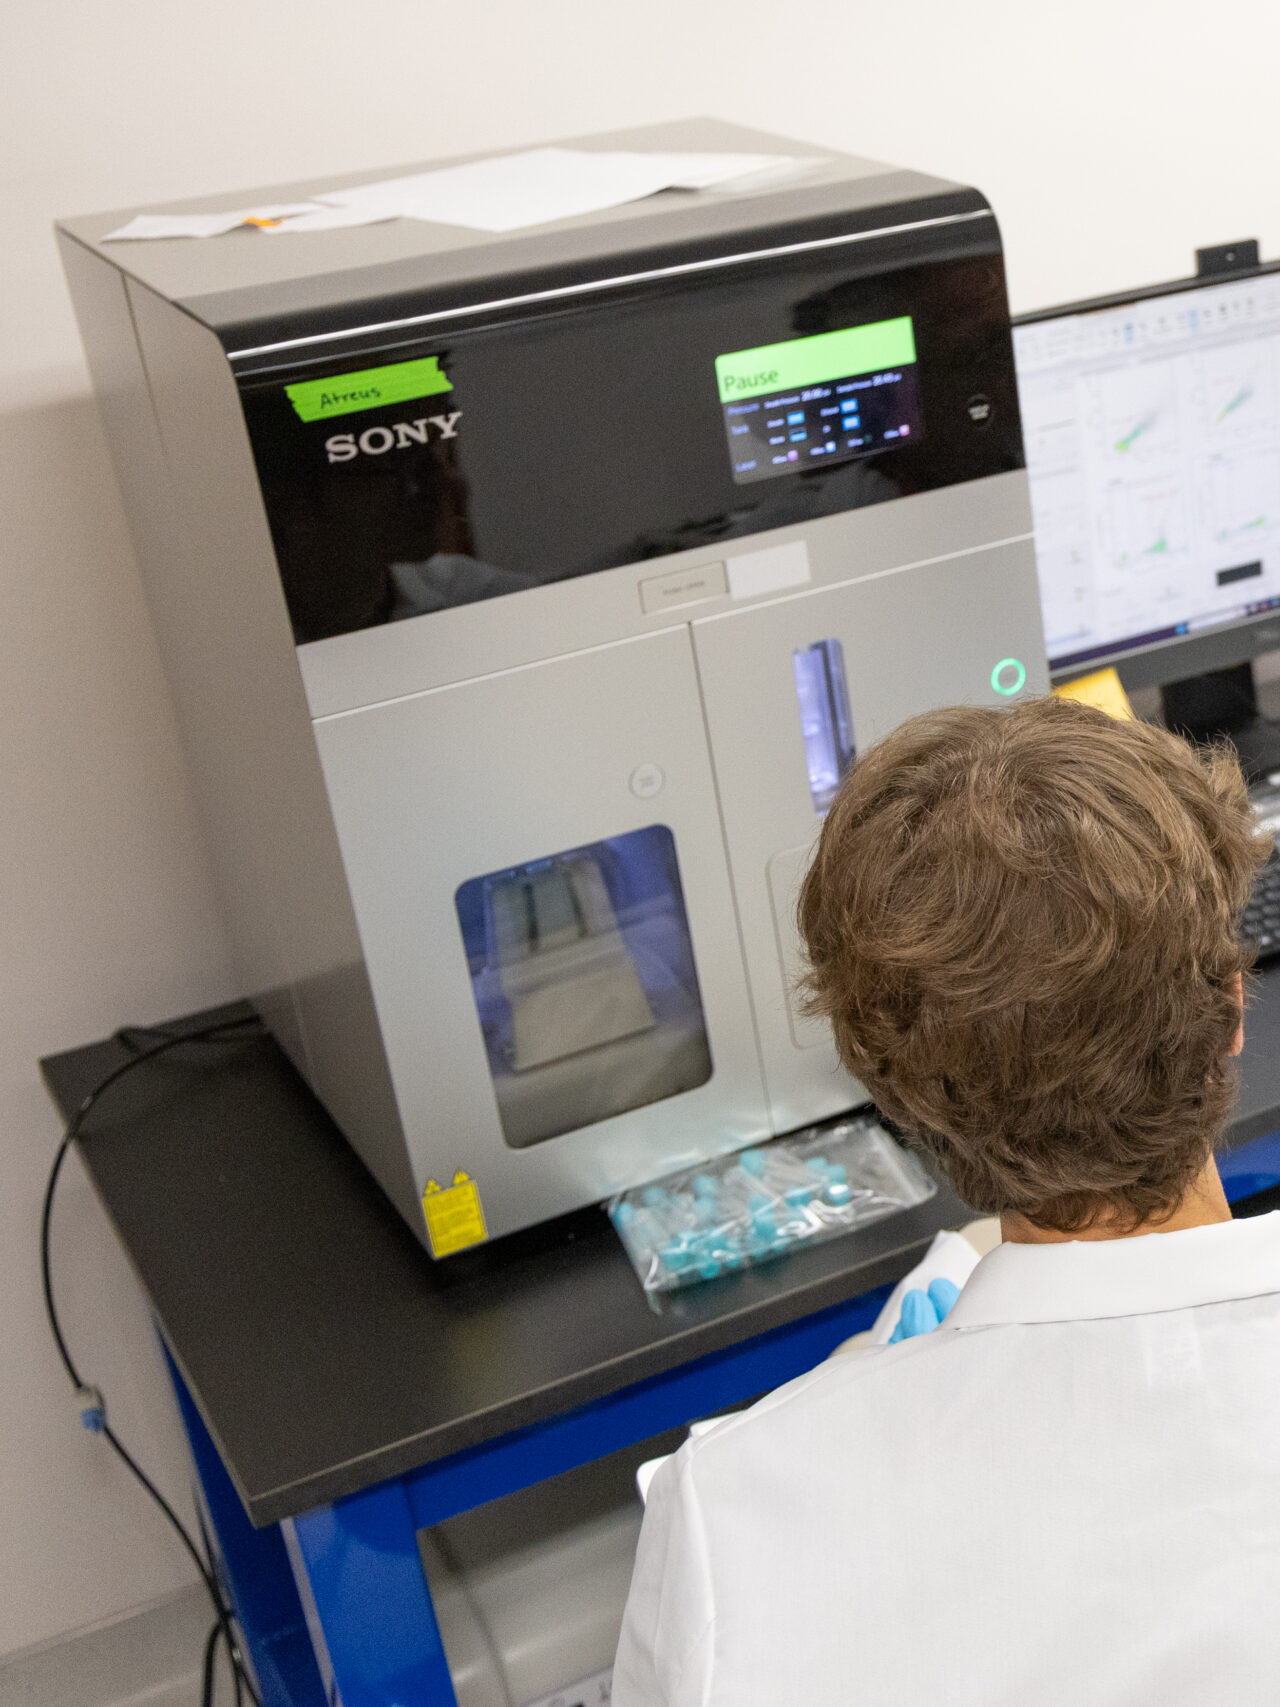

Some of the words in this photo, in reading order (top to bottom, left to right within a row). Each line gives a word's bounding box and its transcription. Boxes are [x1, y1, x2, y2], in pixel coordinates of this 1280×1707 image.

[723, 369, 779, 393] Pause
[320, 386, 381, 409] Atreus
[325, 411, 463, 463] SONY
